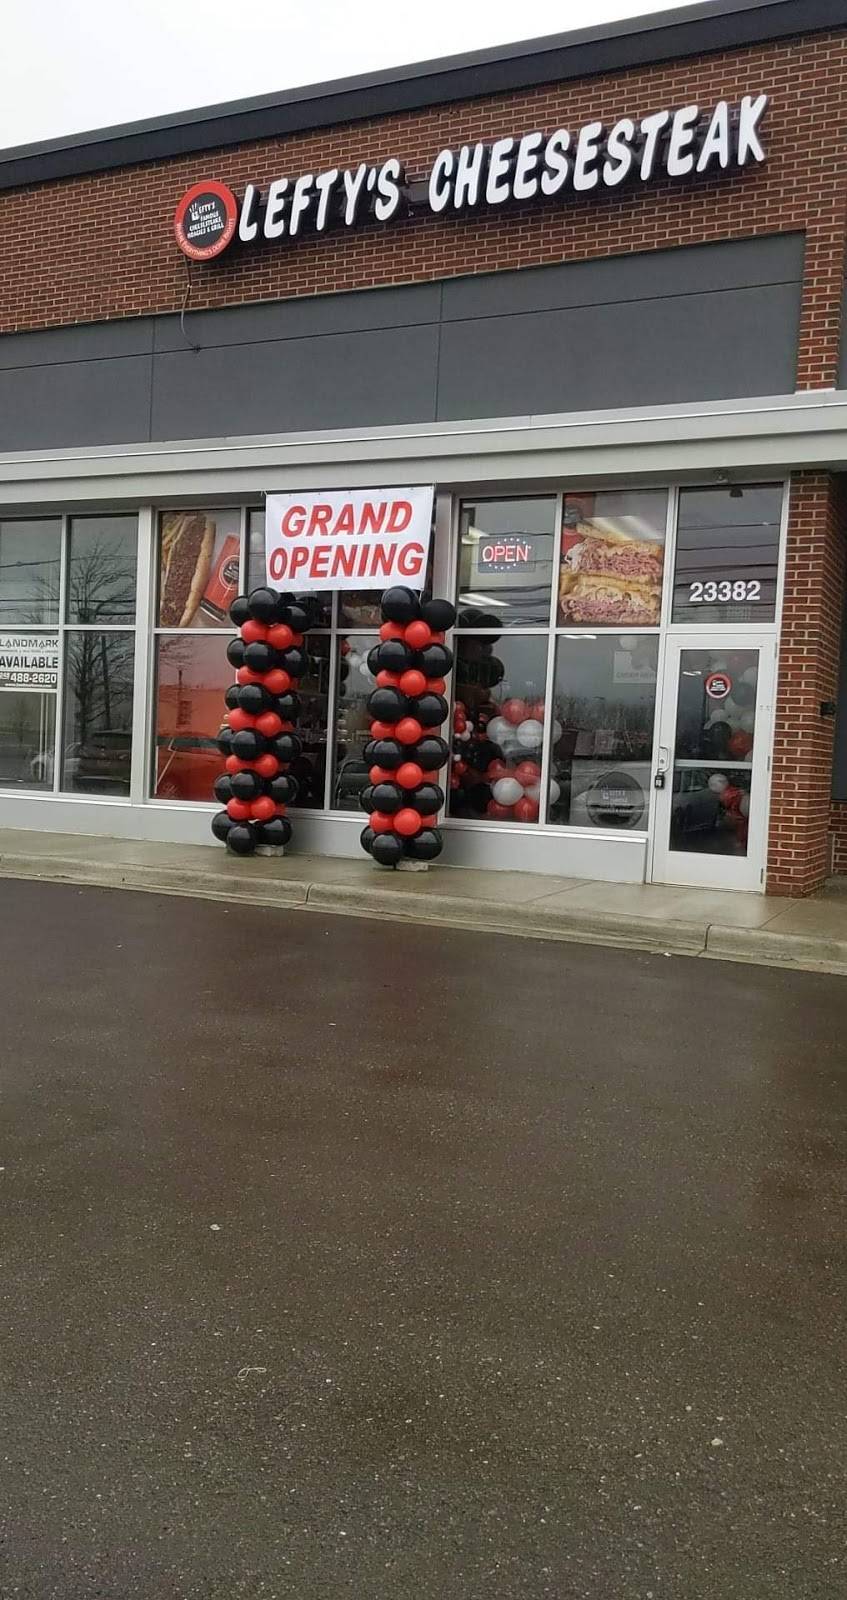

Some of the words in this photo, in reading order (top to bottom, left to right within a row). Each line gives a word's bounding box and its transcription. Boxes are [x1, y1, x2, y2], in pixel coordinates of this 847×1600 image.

[238, 158, 400, 241] LEFTY'S
[428, 94, 767, 212] CHEESESTEAK
[281, 501, 412, 537] GRAND
[269, 542, 424, 580] OPENING
[482, 545, 528, 562] OPEN
[689, 581, 761, 601] 23382
[0, 640, 59, 648] LANDMARK
[0, 656, 58, 668] AVAILABLE
[10, 672, 57, 683] 488-2620
